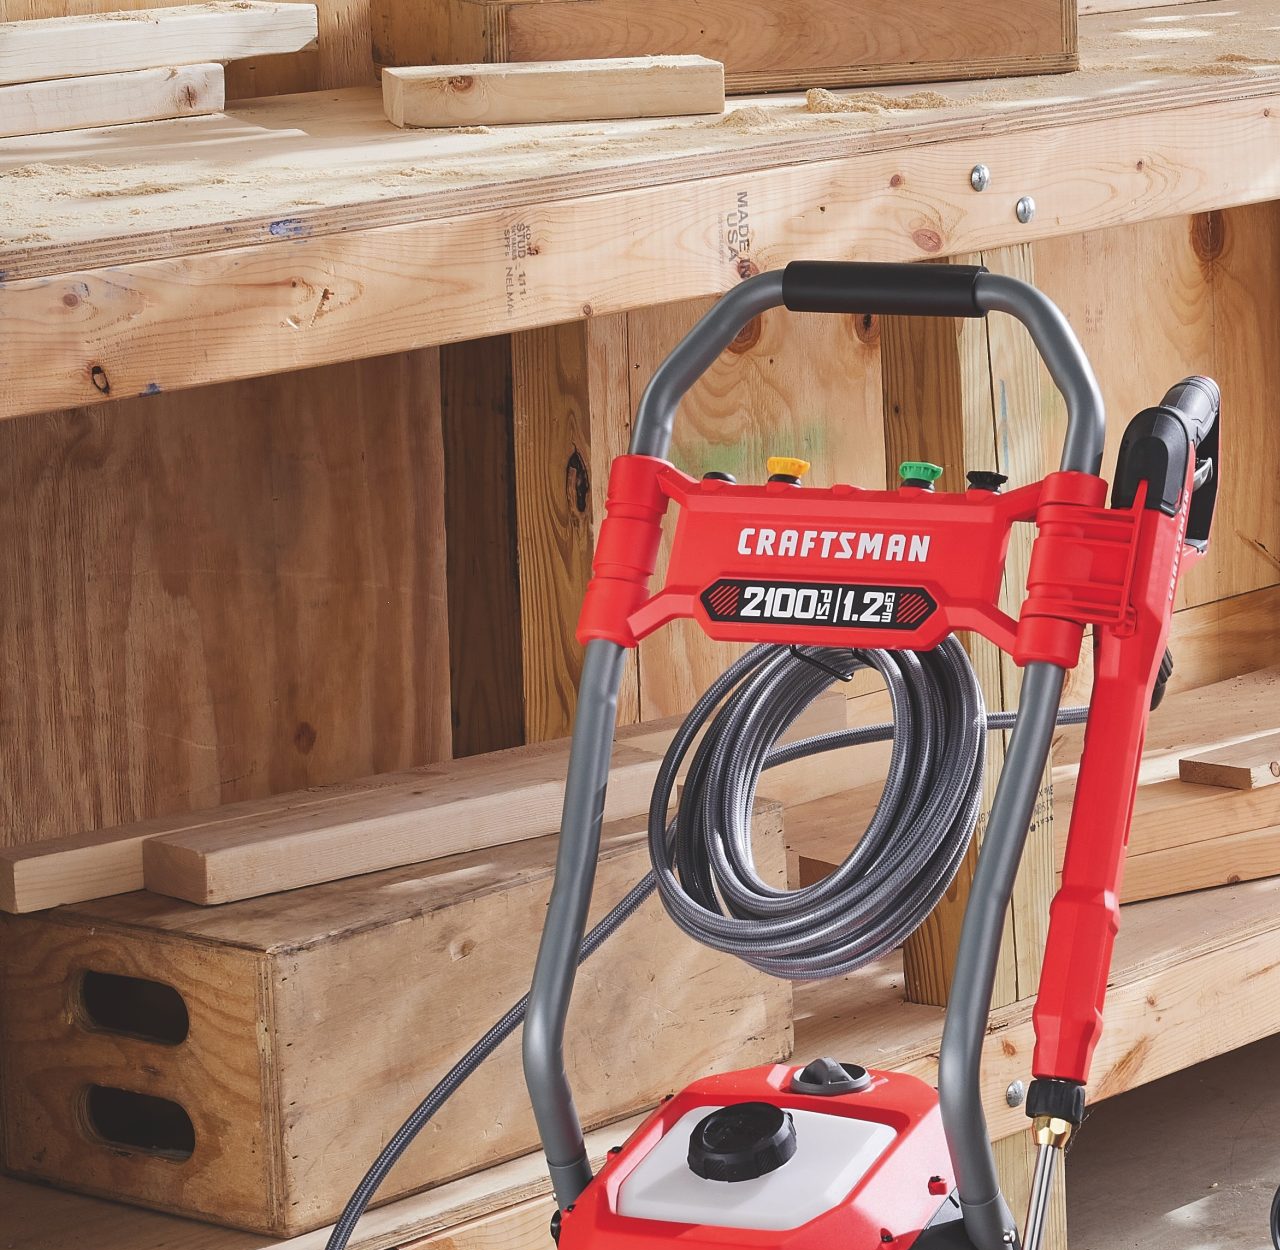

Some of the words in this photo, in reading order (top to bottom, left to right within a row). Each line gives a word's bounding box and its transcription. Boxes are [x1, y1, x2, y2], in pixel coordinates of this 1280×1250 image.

[727, 212, 739, 262] USA
[737, 191, 750, 253] MADE
[517, 223, 526, 259] STUD
[737, 528, 930, 562] CRAFTSMAN
[740, 586, 818, 619] 2100
[815, 589, 832, 619] PSI
[842, 591, 884, 622] 1.2
